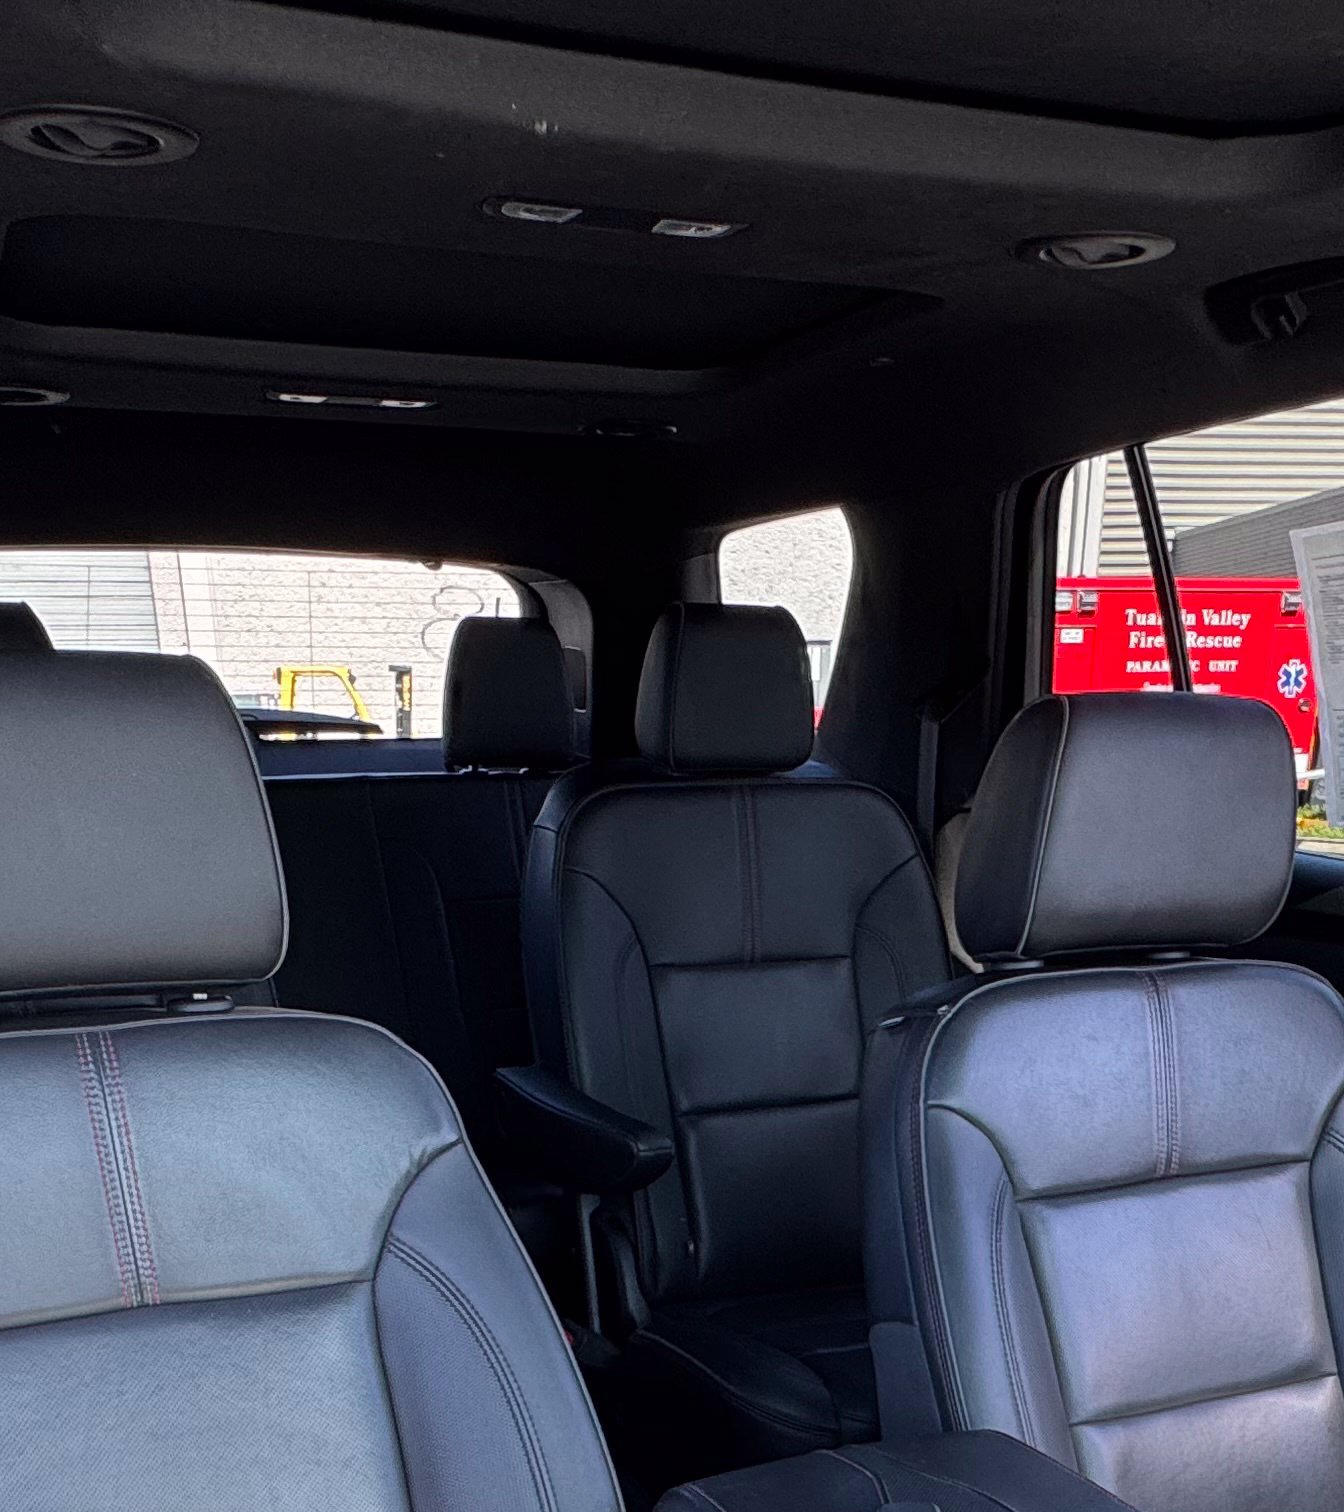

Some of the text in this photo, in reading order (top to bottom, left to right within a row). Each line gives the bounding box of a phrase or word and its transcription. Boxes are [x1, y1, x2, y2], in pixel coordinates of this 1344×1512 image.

[1202, 608, 1252, 630] Valley
[1128, 631, 1243, 648] Fire Rescue
[1208, 660, 1239, 673] UNIT
